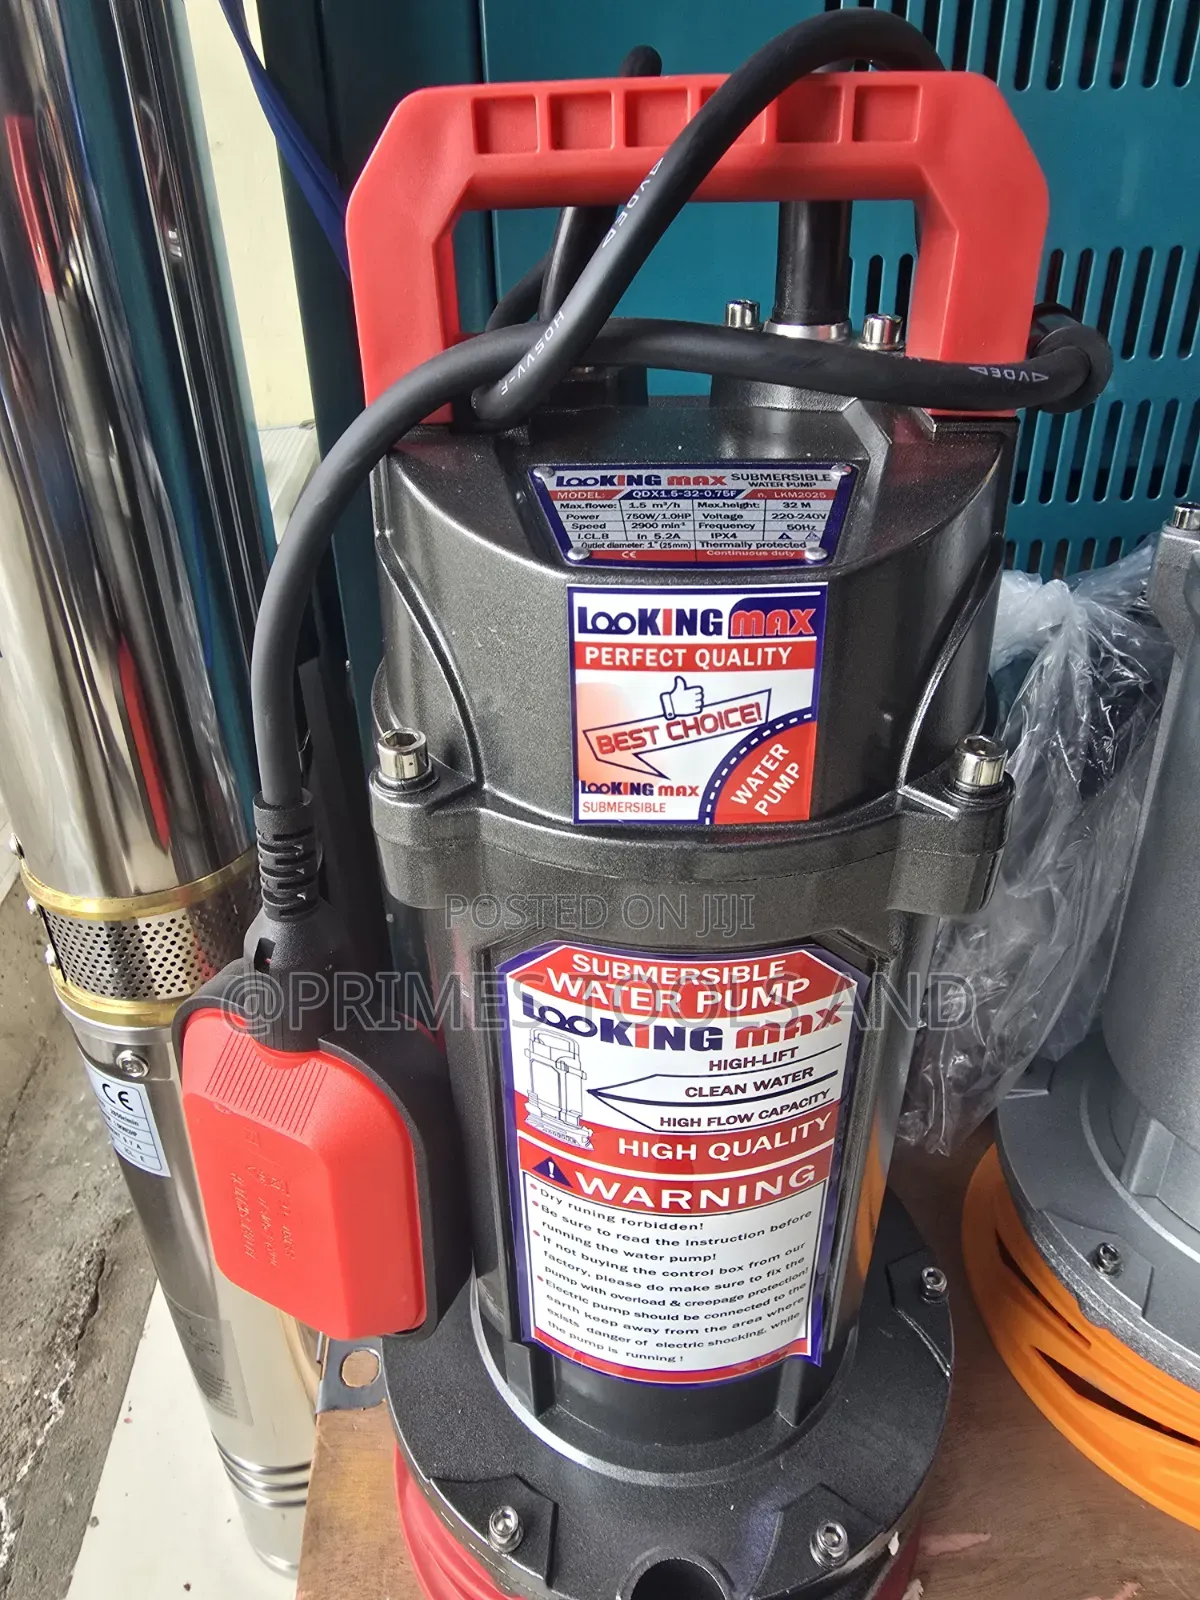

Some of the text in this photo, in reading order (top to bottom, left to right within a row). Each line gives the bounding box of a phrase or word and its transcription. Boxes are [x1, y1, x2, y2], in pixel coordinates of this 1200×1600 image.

[731, 473, 831, 482] SUBMERSIBLE
[557, 491, 606, 499] MODEL:
[774, 491, 827, 499] LKM2025
[782, 501, 812, 509] 32 M
[571, 522, 606, 530] Speed
[626, 513, 692, 521] 750W/1.0HP
[698, 522, 756, 531] Frequency
[702, 513, 743, 521] Voltage
[581, 541, 605, 549] Outlet
[606, 541, 645, 549] diameter:
[700, 541, 807, 550] Thermally protected
[710, 532, 738, 540] IPX4
[771, 549, 796, 558] duty
[585, 646, 793, 669] PERFECT QUALITY
[595, 701, 763, 755] BEST CHOICE!
[730, 742, 790, 806] WATER
[754, 762, 801, 816] PUMP
[582, 801, 667, 813] SUBMERSIBLE
[571, 953, 786, 986] SUBMERSIBLE
[547, 967, 811, 1014] WATER PUMP
[708, 1046, 799, 1072] HIGH-LIFT
[684, 1066, 815, 1099] CLEAN WATER
[659, 1088, 831, 1128] HIGH FLOW CAPACITY
[618, 1112, 832, 1161] HIGH QUALITY
[575, 1163, 815, 1210] WARNING
[540, 1188, 704, 1231] Dry runing forbidden!
[541, 1204, 558, 1217] Be
[561, 1216, 592, 1231] sure
[597, 1227, 611, 1237] to
[616, 1233, 650, 1244] read
[655, 1238, 680, 1247] the
[769, 1210, 812, 1233] before
[542, 1221, 717, 1263] running the water pump!
[555, 1242, 577, 1257] not
[581, 1252, 629, 1273] buying
[633, 1266, 657, 1276] the
[661, 1269, 714, 1277] control
[719, 1264, 744, 1275] box
[748, 1253, 780, 1269] from
[784, 1242, 806, 1257] our
[595, 1273, 642, 1289] please
[646, 1284, 665, 1292] do
[669, 1284, 711, 1292] make
[714, 1280, 745, 1290] sure
[749, 1274, 762, 1283] to
[766, 1267, 782, 1278] fix
[785, 1256, 805, 1270] the
[544, 1266, 809, 1307] pump with overload & creepage protection!
[545, 1279, 589, 1304] Electric
[592, 1301, 631, 1317] pump
[633, 1311, 680, 1321] should
[704, 1298, 771, 1320] connected
[773, 1293, 786, 1302] to
[788, 1282, 807, 1296] the
[546, 1294, 580, 1315] earth
[584, 1311, 619, 1327] keep
[623, 1325, 660, 1335] away
[704, 1325, 727, 1334] the
[731, 1316, 763, 1329] area
[766, 1296, 805, 1318] where
[546, 1307, 580, 1328] exists
[586, 1326, 632, 1343] danger
[635, 1339, 649, 1347] of
[655, 1341, 705, 1349] electric
[770, 1311, 801, 1330] while
[547, 1320, 567, 1335] the
[569, 1332, 605, 1351] pump
[608, 1346, 619, 1355] is
[625, 1350, 677, 1363] running
